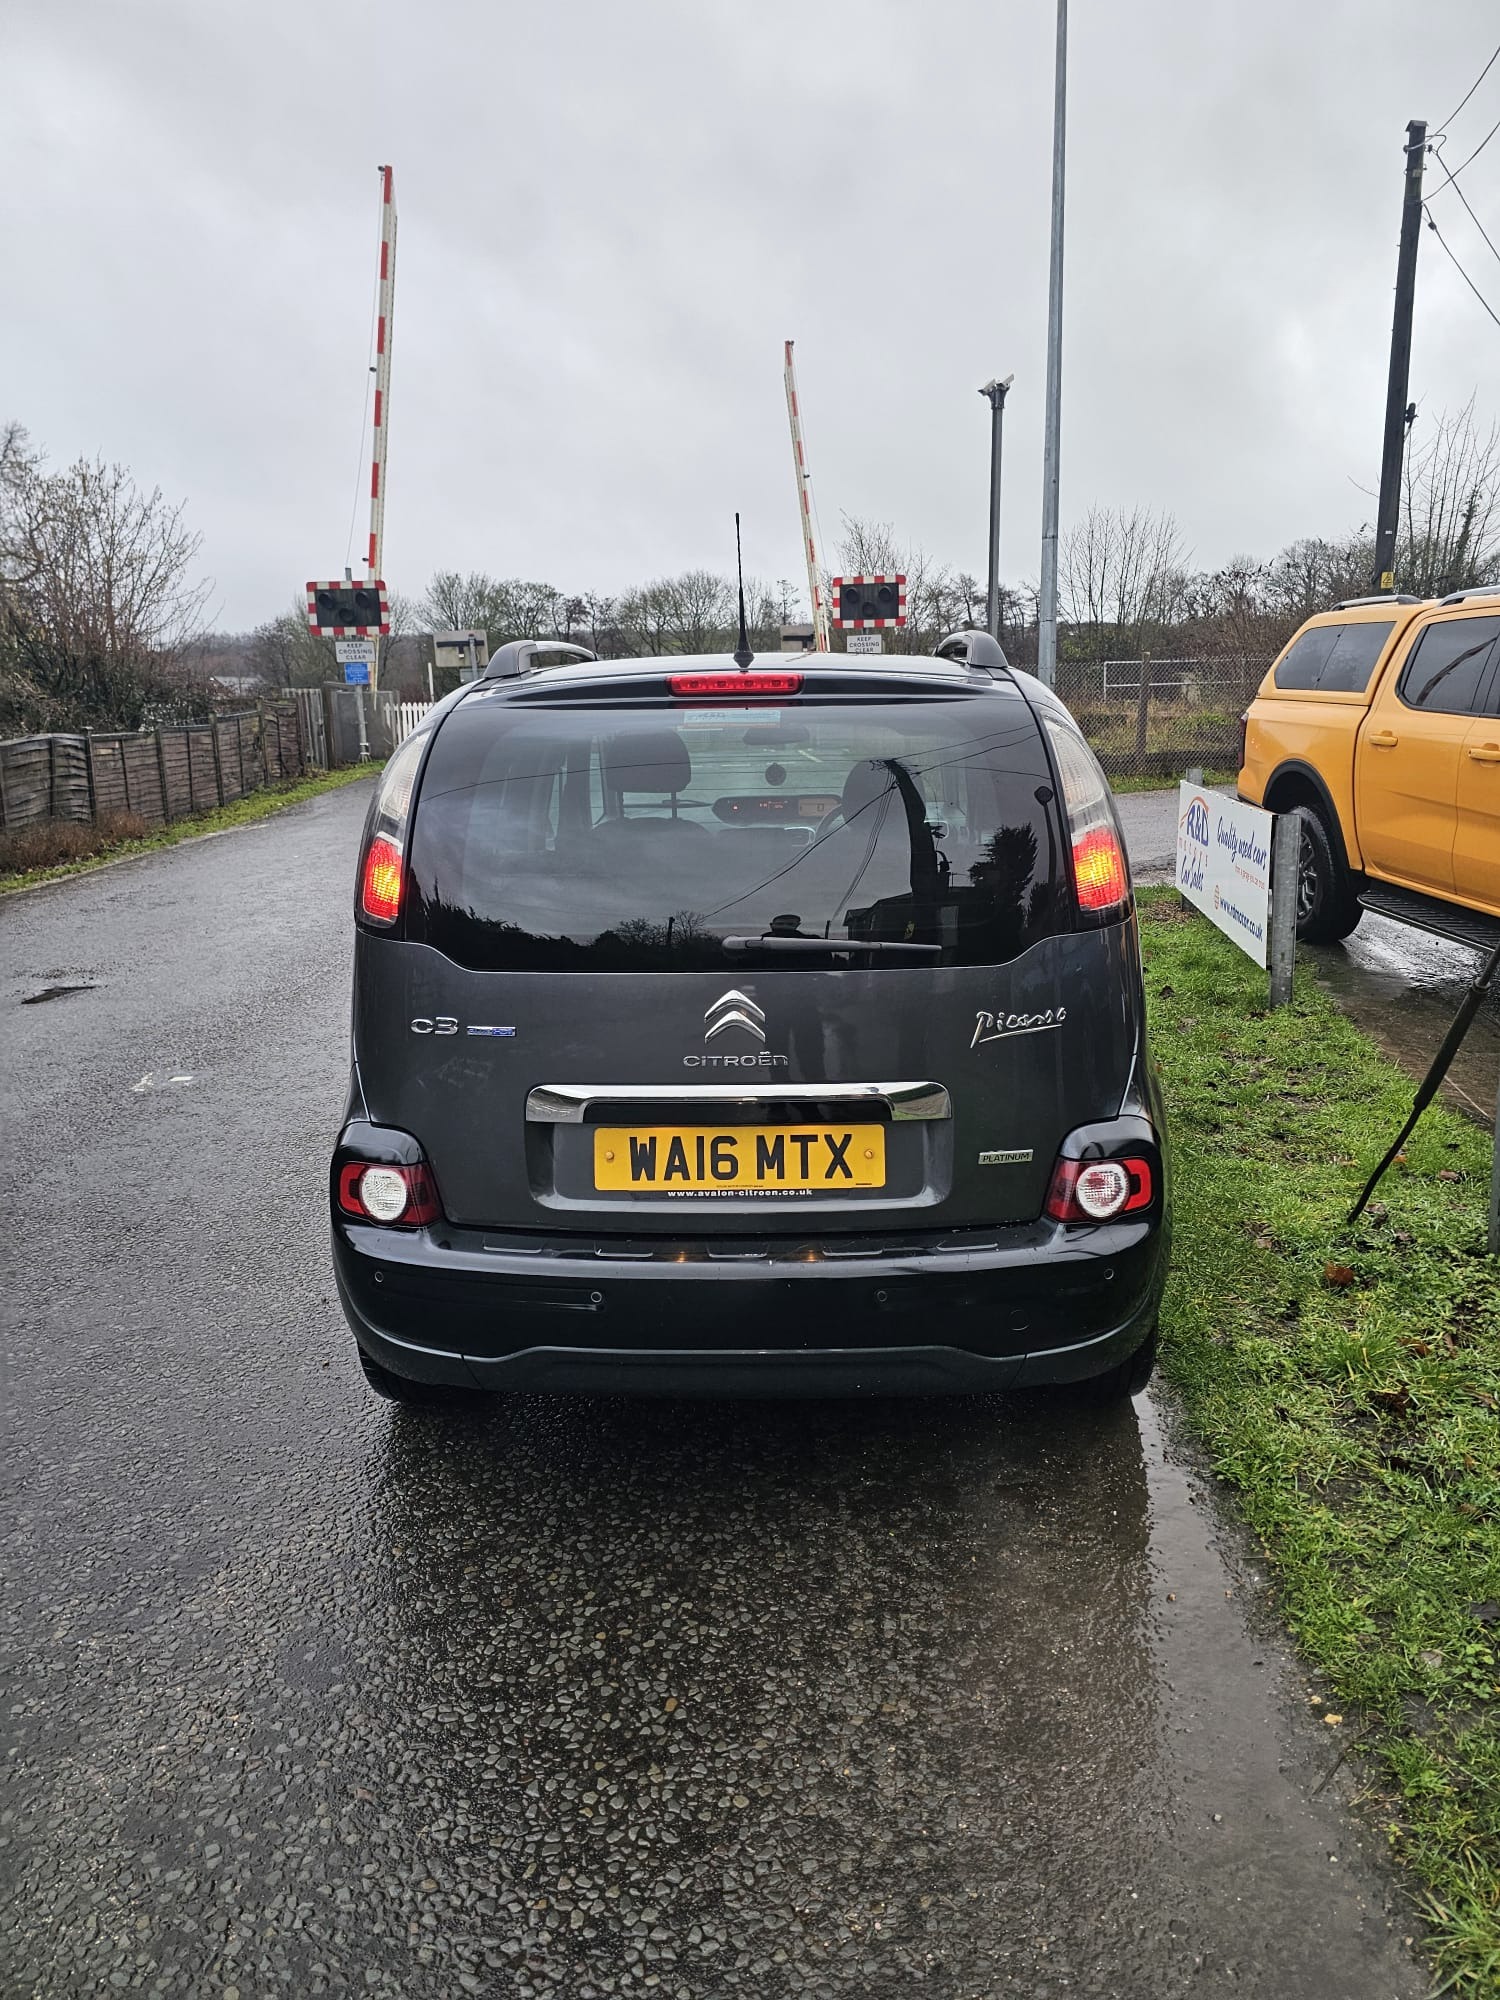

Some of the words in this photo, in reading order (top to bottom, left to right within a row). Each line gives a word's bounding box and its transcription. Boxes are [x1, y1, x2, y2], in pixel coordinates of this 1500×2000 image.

[1187, 804, 1209, 847] R&D
[1217, 815, 1238, 864] Quality
[1238, 829, 1255, 860] used
[1253, 846, 1267, 871] cars
[410, 1016, 459, 1035] C3
[629, 1135, 739, 1181] WA16
[756, 1133, 853, 1180] MTX
[982, 1152, 1030, 1163] PLATINUM
[667, 1188, 813, 1197] www.avalon-citroen.co.uk
